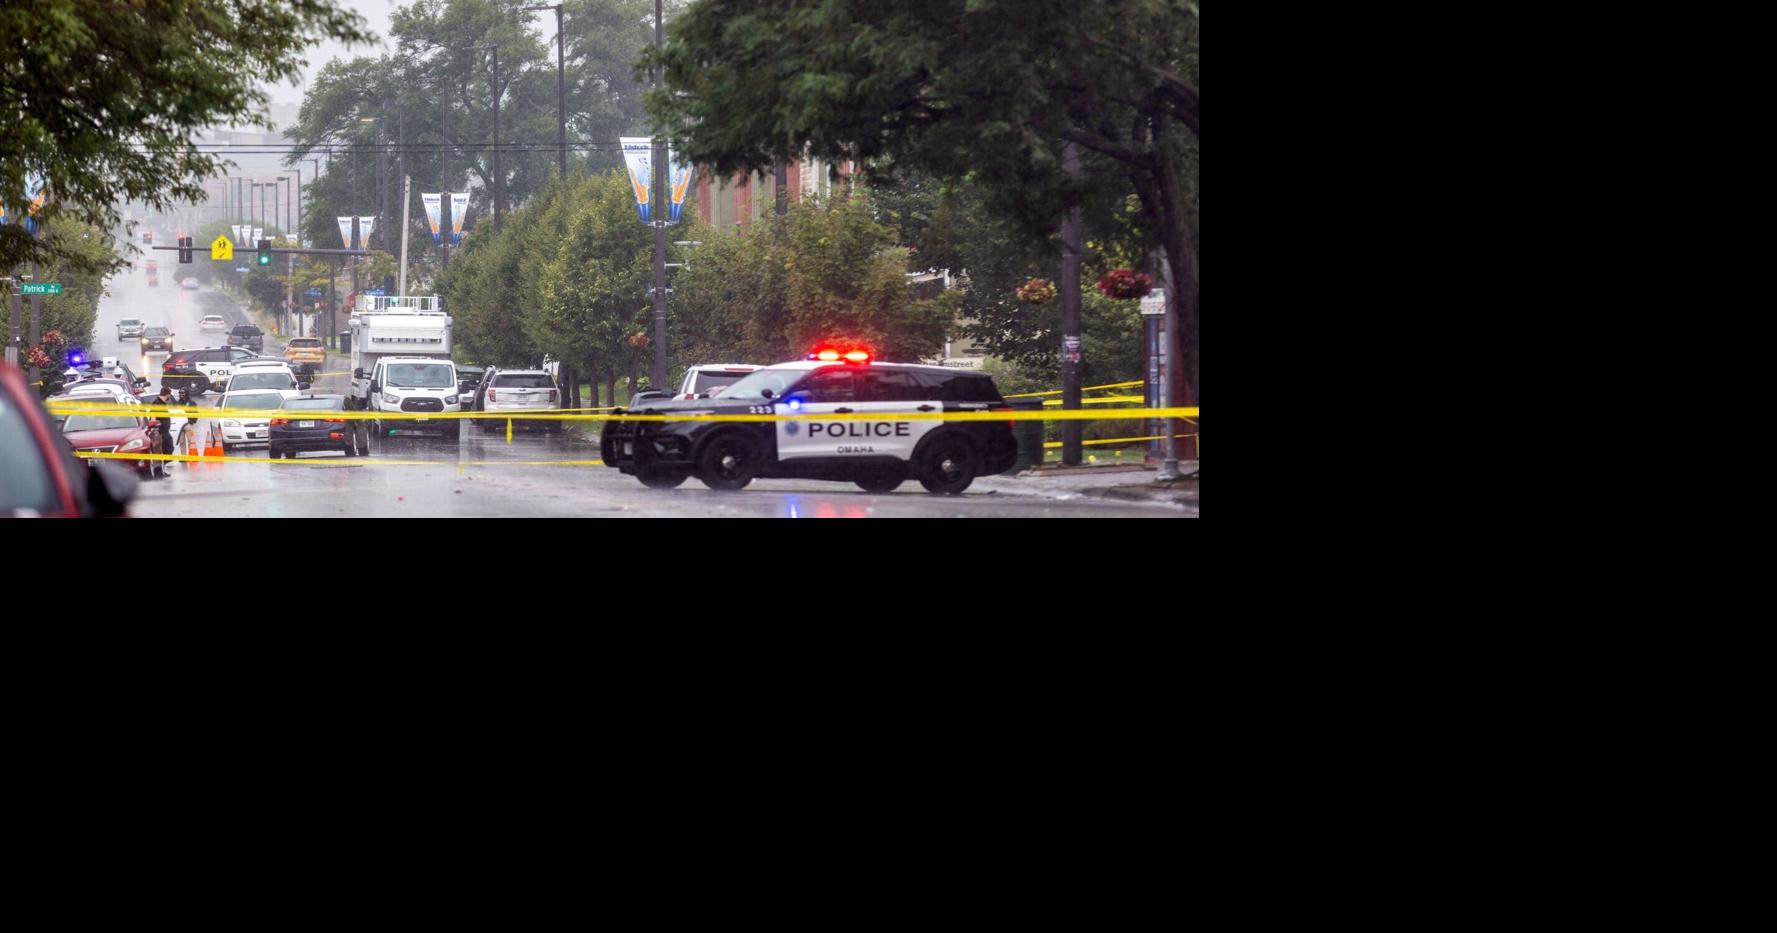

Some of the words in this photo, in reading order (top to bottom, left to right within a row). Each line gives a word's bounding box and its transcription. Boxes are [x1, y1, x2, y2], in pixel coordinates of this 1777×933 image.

[23, 285, 45, 293] Patrick
[749, 406, 772, 414] 223
[808, 422, 911, 437] POLICE
[837, 446, 875, 454] OMAHA
